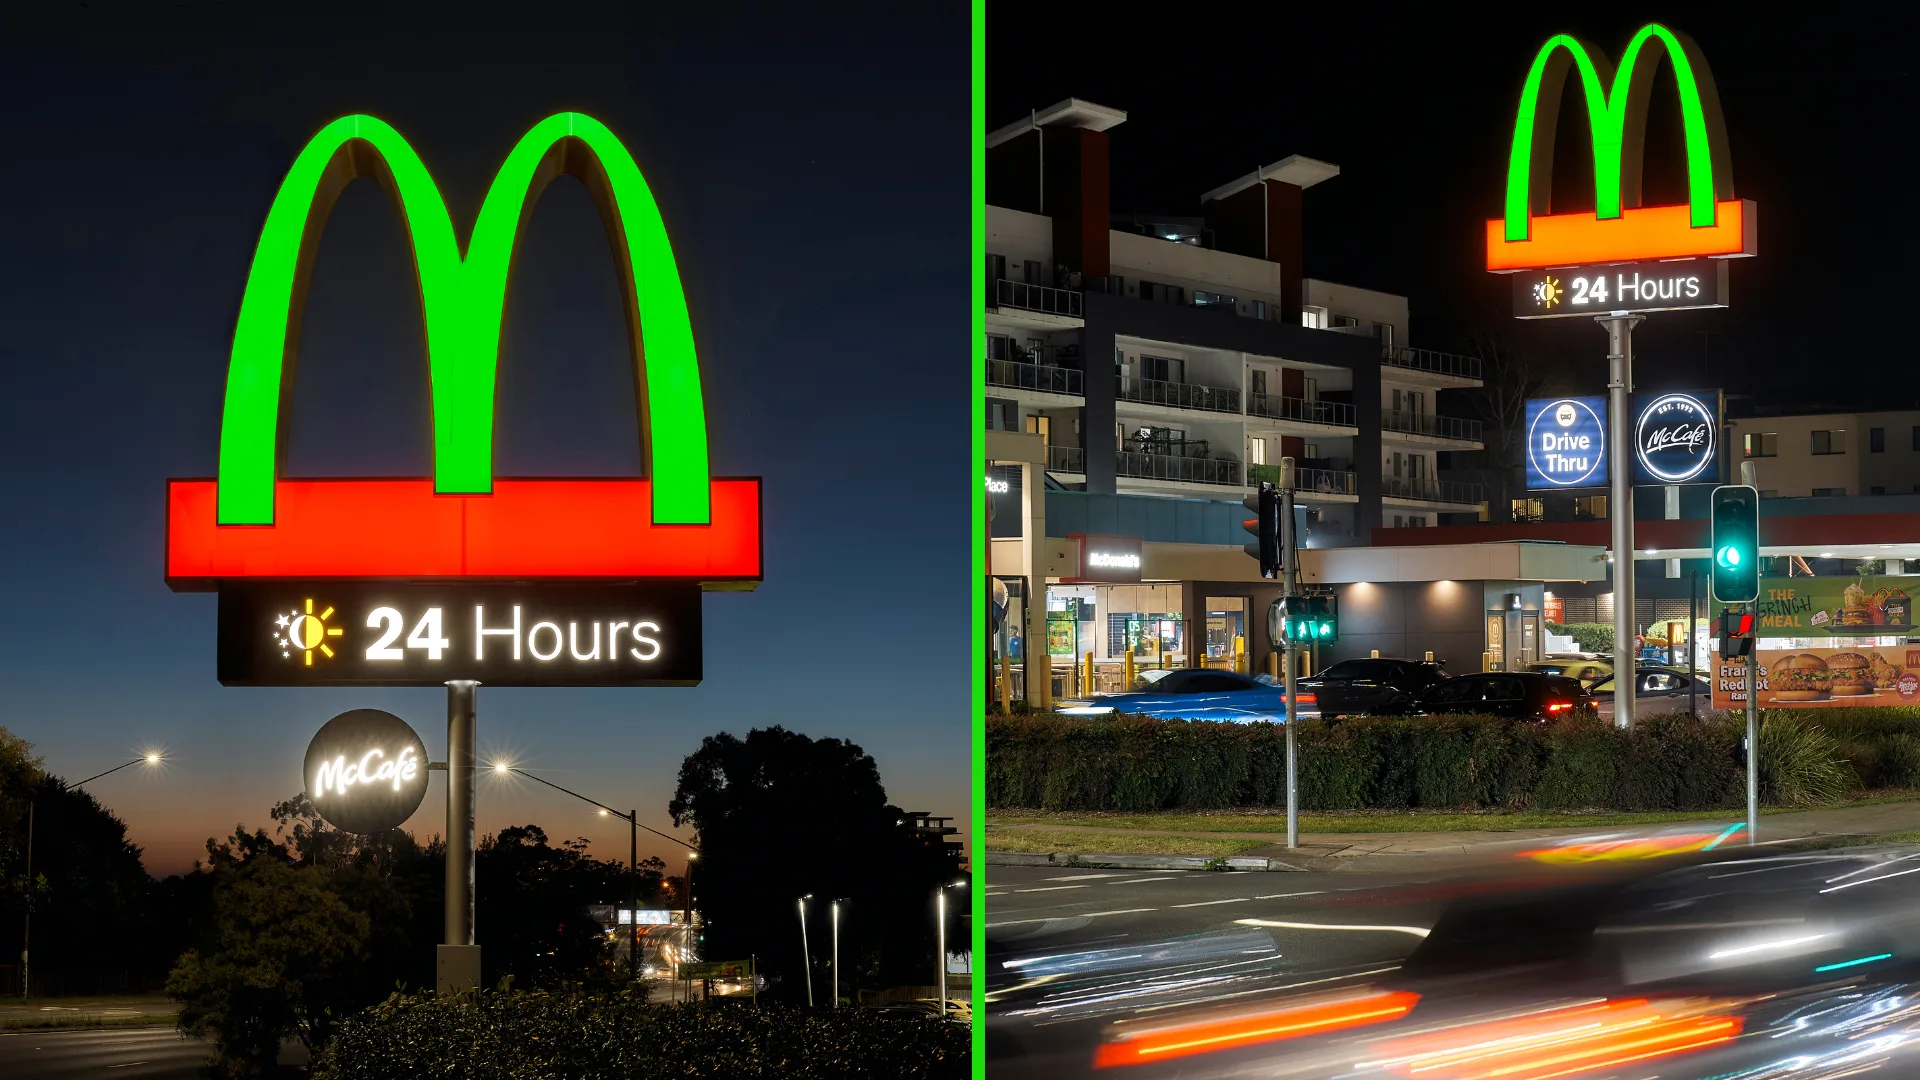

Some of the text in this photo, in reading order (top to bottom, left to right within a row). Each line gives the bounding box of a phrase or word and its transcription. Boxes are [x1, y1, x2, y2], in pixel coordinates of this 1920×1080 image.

[1571, 273, 1700, 305] 24 Hours
[1542, 432, 1590, 451] Drive
[1647, 423, 1706, 455] McCafé
[1546, 454, 1588, 472] Thru
[1768, 589, 1796, 600] THE
[1762, 615, 1802, 628] MEAL
[365, 604, 662, 662] 24 Hours
[1720, 664, 1768, 678] Fran's
[1720, 679, 1769, 691] Redot
[314, 745, 418, 798] McCafé
